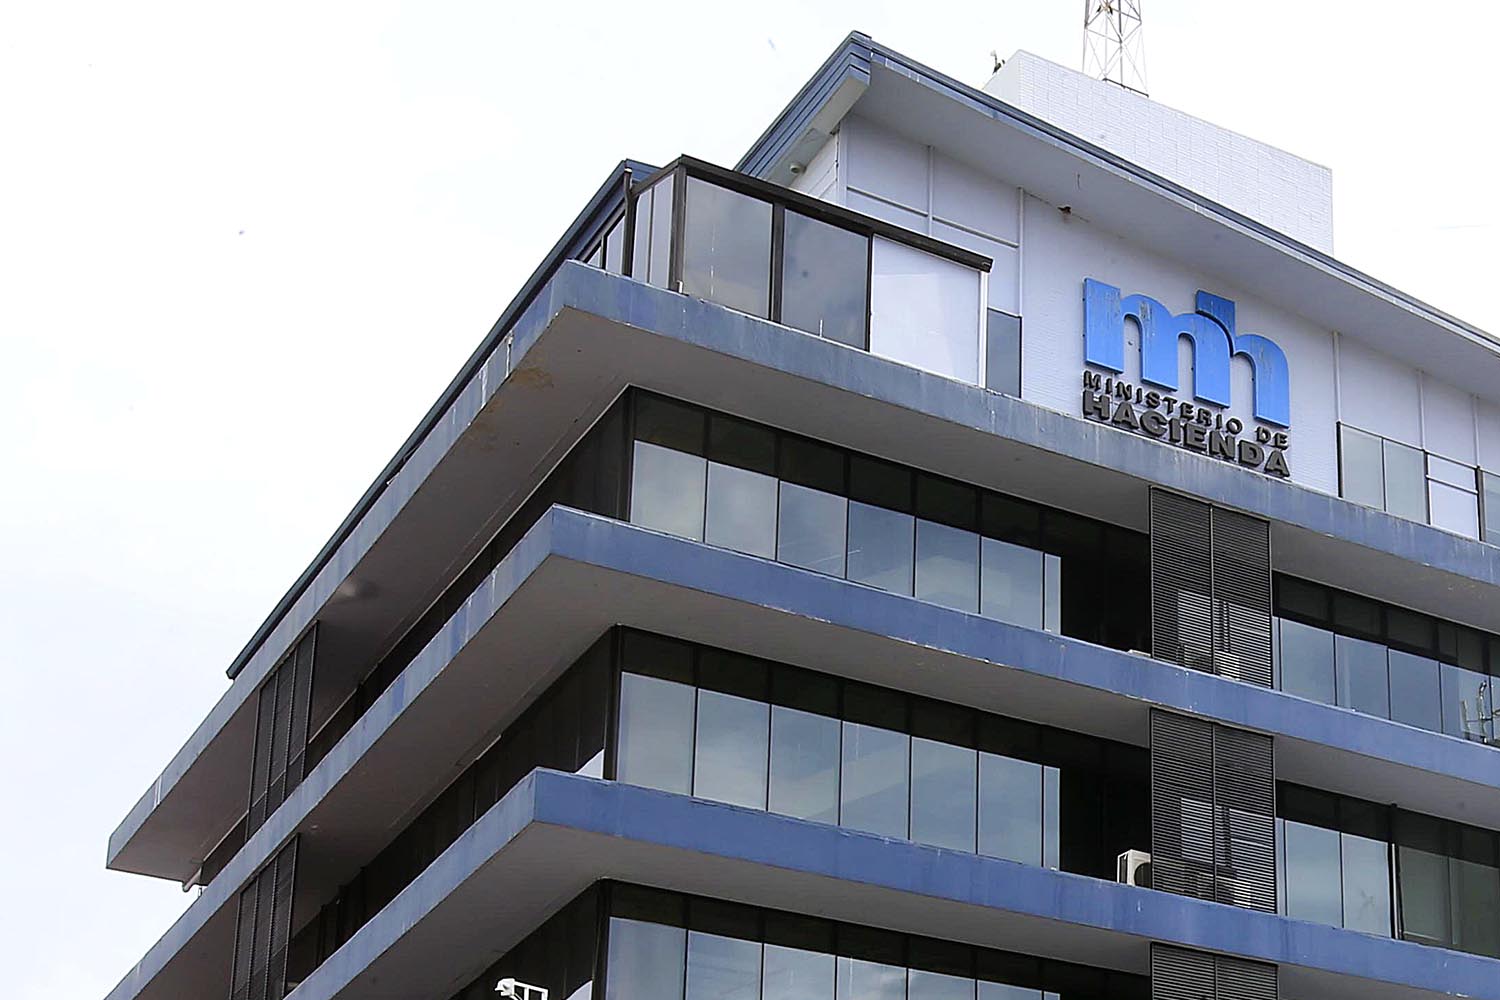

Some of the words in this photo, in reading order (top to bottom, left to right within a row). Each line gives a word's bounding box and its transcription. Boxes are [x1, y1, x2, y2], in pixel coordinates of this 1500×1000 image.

[1083, 371, 1243, 433] MINISTERIO
[1256, 427, 1288, 449] DE
[1083, 389, 1290, 477] HACIENDA
